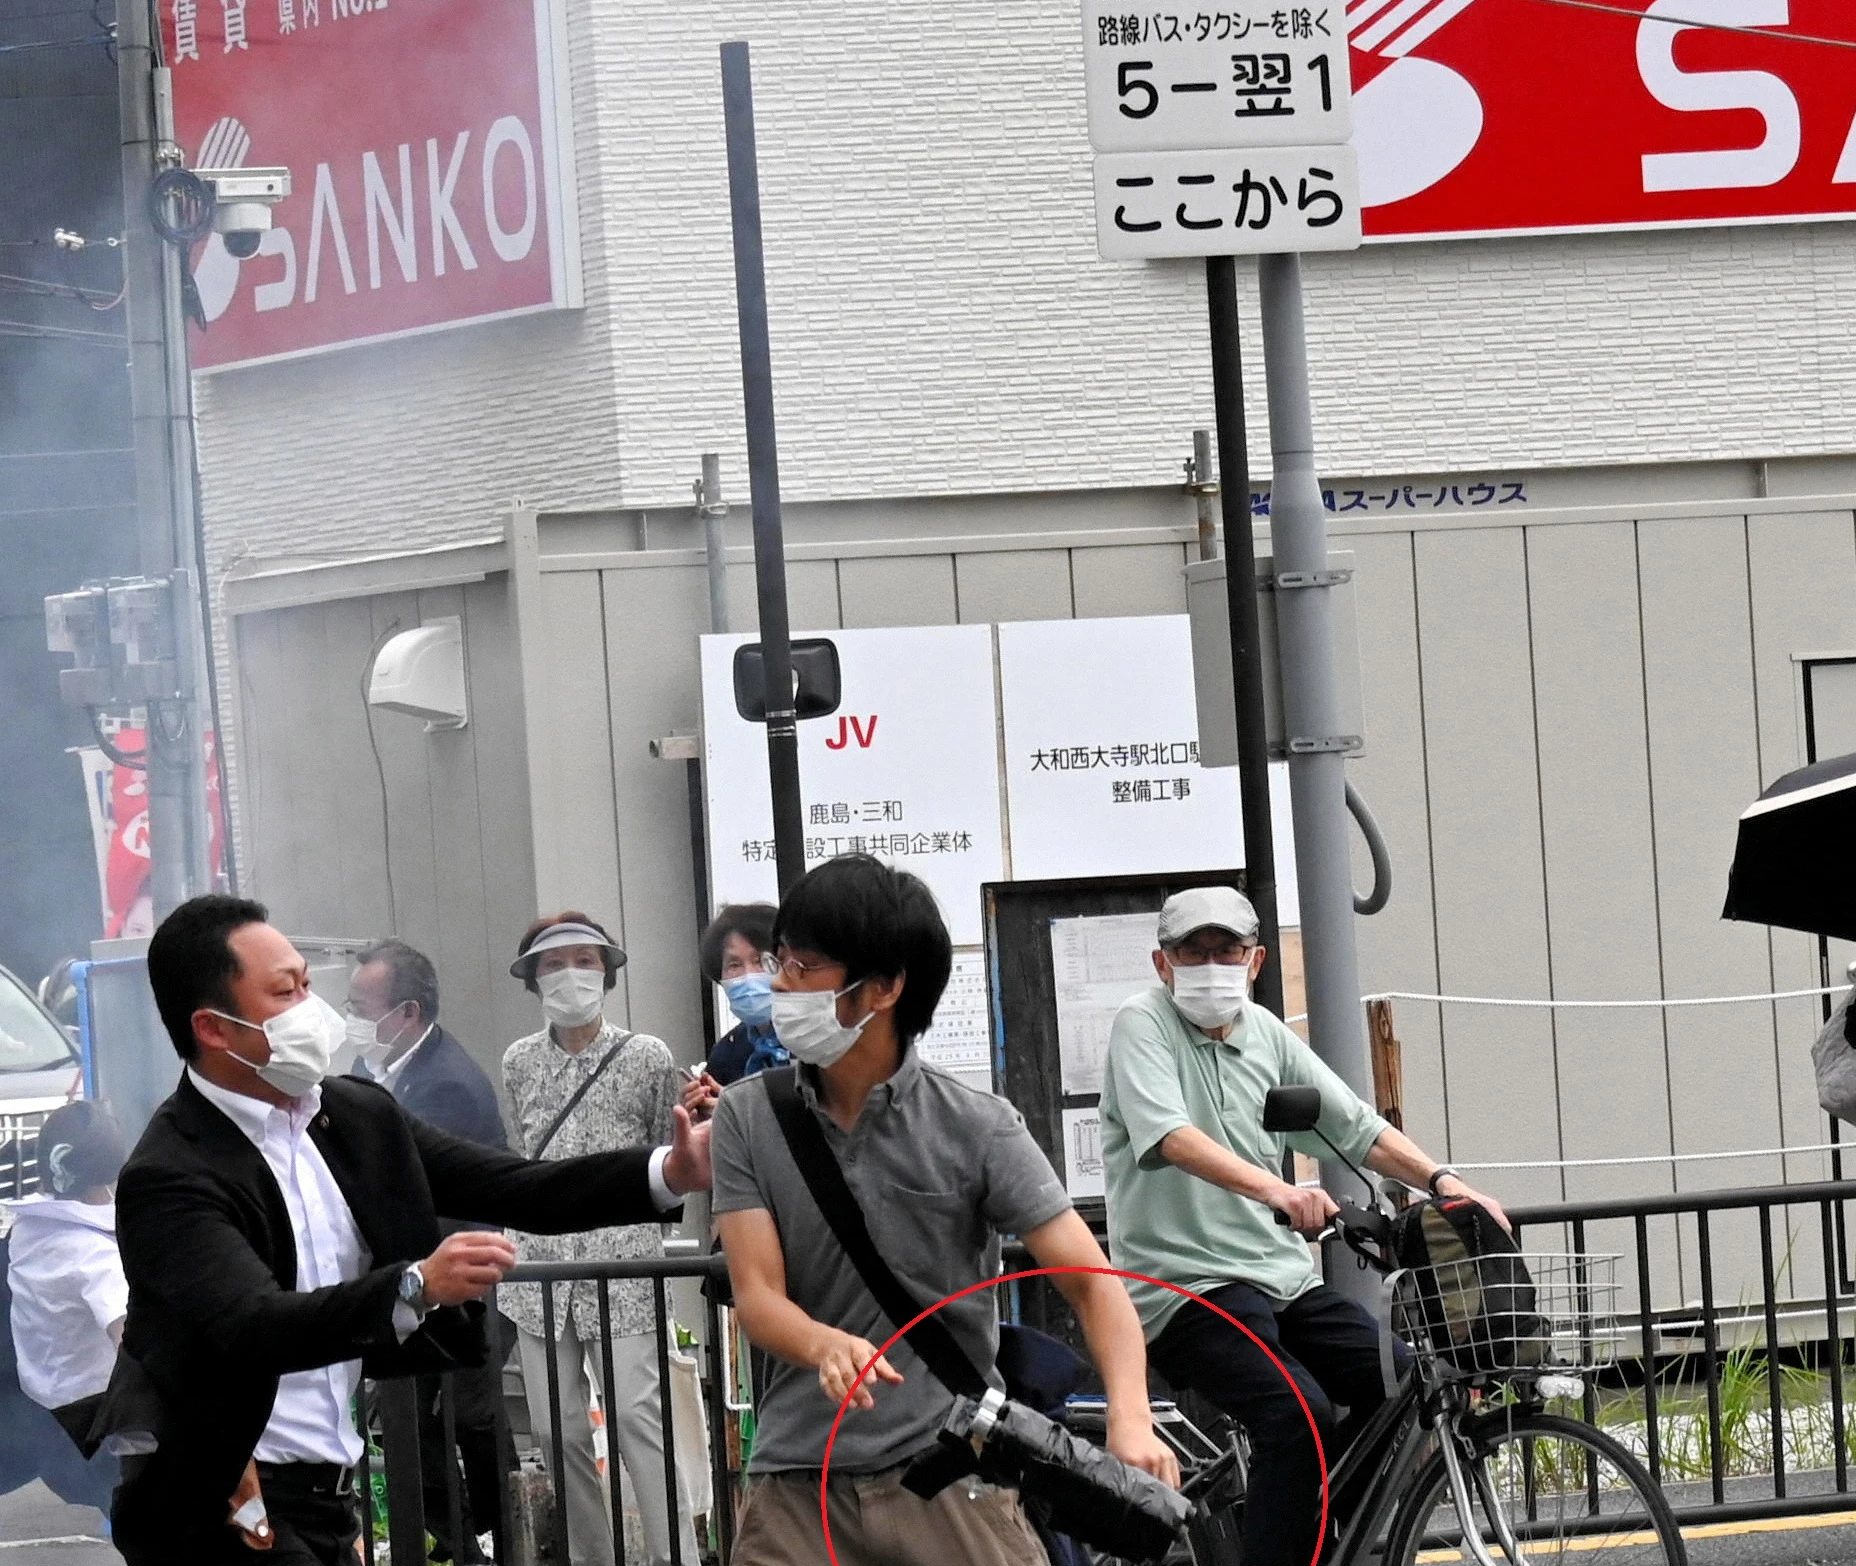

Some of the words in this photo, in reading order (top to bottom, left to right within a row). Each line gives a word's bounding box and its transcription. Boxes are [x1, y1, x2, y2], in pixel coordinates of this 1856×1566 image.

[1097, 8, 1331, 46] 路線バス・タクシーを除く
[1114, 168, 1344, 232] ここから
[825, 715, 878, 750] JV
[1112, 777, 1191, 803] 整備工事
[809, 800, 903, 825] 鹿島・三和
[742, 830, 973, 862] 特定設工事共同企業体
